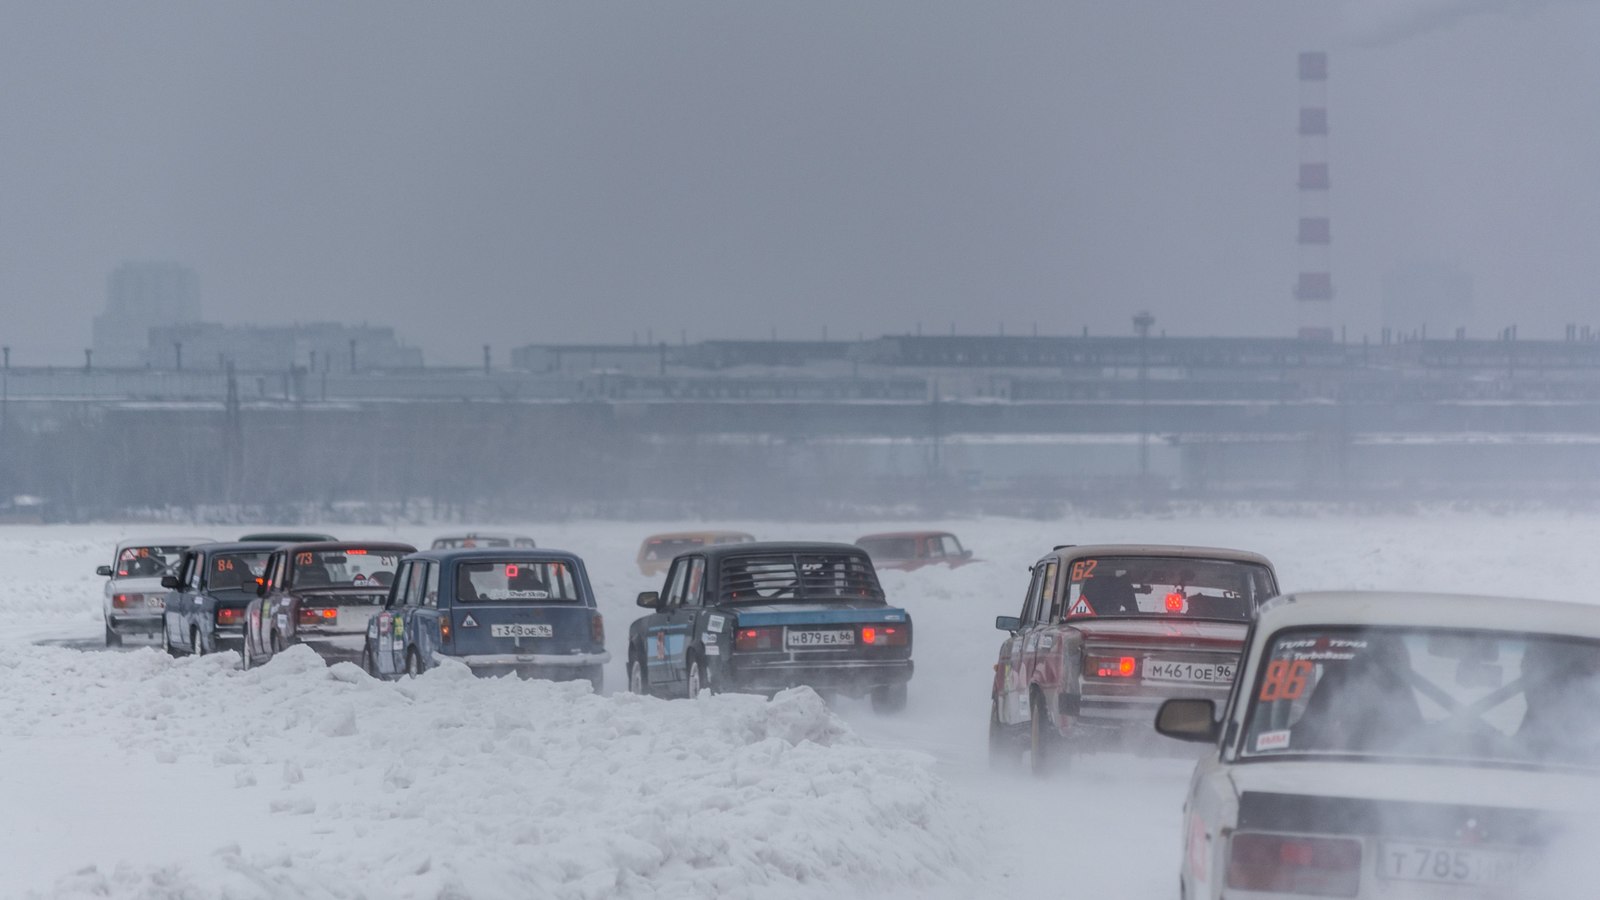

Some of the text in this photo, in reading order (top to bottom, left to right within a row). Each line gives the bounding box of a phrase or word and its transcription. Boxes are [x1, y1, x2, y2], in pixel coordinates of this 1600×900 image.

[217, 559, 233, 571] 84
[298, 552, 313, 565] 73
[1072, 559, 1098, 582] 62
[839, 632, 851, 640] 66
[1152, 664, 1232, 681] М461ОЕ 96
[1260, 659, 1313, 702] 86
